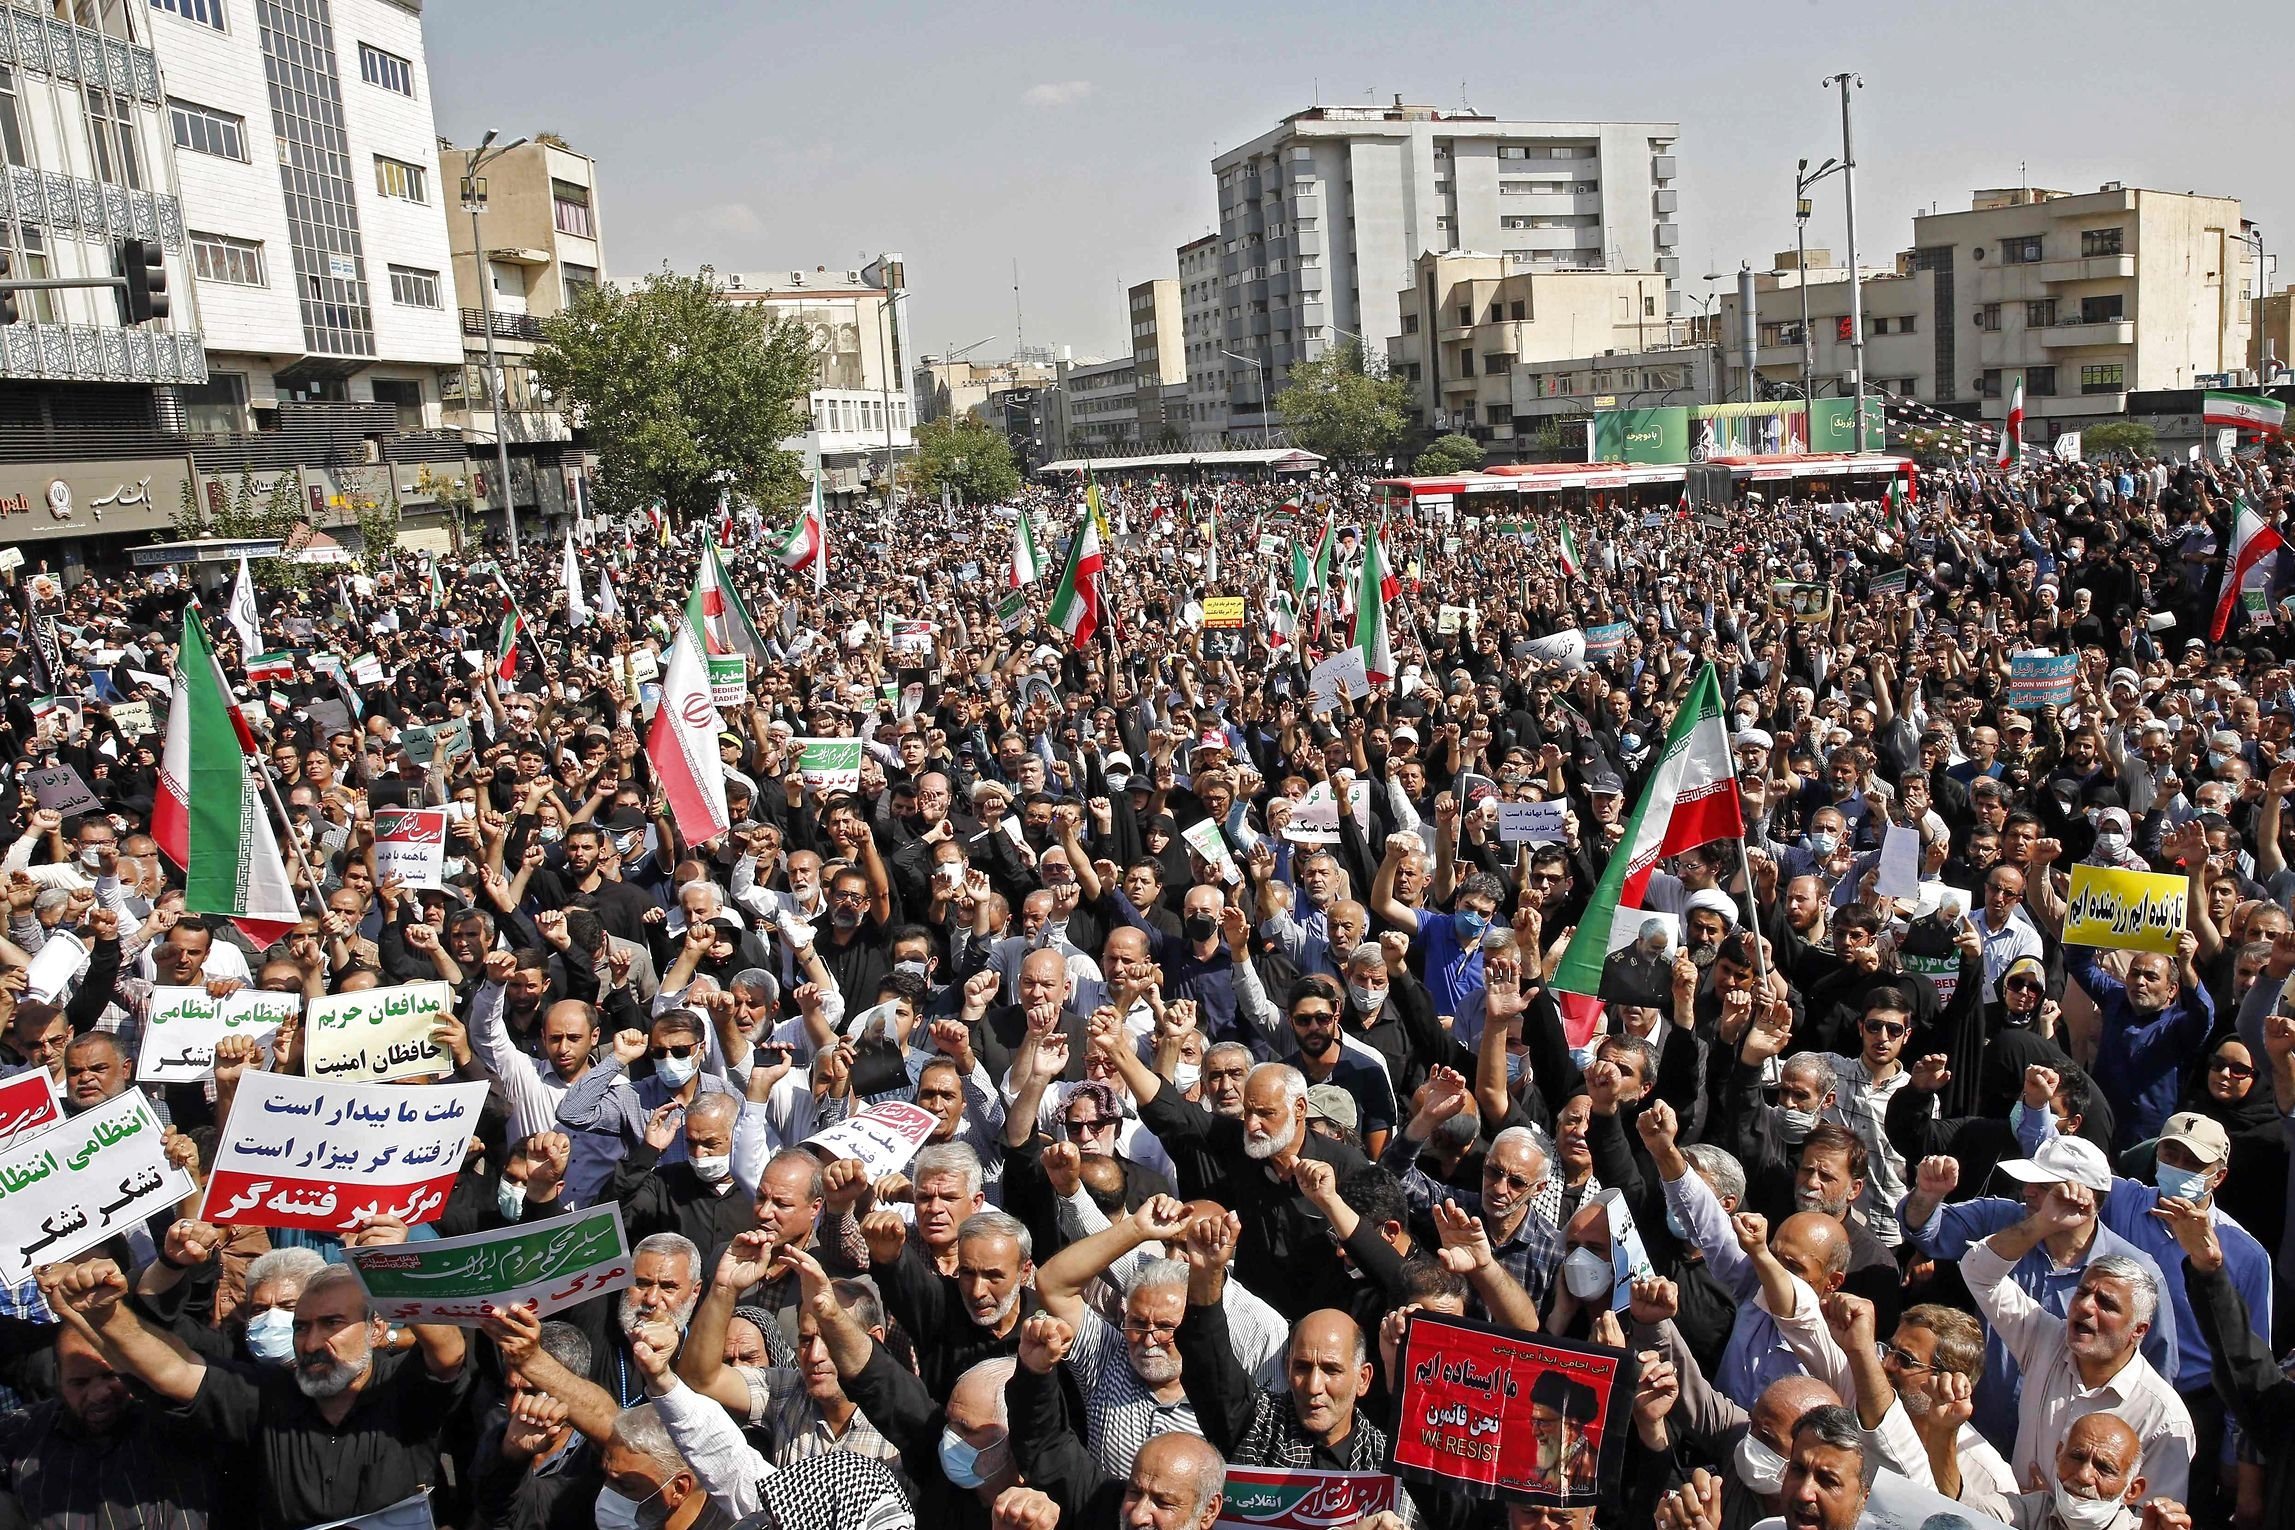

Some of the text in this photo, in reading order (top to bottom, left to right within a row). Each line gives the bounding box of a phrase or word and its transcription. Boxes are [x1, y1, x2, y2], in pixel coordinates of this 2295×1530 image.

[135, 551, 166, 562] POLICE
[711, 686, 744, 694] BEDIENT
[2035, 680, 2054, 688] WITH
[2054, 678, 2073, 687] ISRAEL
[1505, 809, 1523, 818] است
[1524, 808, 1542, 819] بهانه
[152, 999, 222, 1025] انتظامی
[317, 993, 441, 1031] مدافعان حریم
[314, 1040, 442, 1078] حافظان امنیت
[263, 1095, 465, 1129] ملت ما بیدار است
[66, 1104, 150, 1172] انتظامی
[847, 1142, 877, 1164] فتنه
[849, 1120, 896, 1154] ملت ما
[233, 1136, 466, 1173] از فتنه گر بیزار است
[336, 1200, 379, 1230] بر
[386, 1184, 443, 1224] مرگ
[401, 1247, 498, 1281] ایران
[551, 1265, 627, 1301] مرگ
[431, 1299, 500, 1320] فتنه
[1414, 1352, 1519, 1400] ما ایستاده ایم
[1426, 1401, 1469, 1428] قائمون
[1420, 1427, 1502, 1463] WE RESIST
[1236, 1493, 1281, 1509] انقلابی
